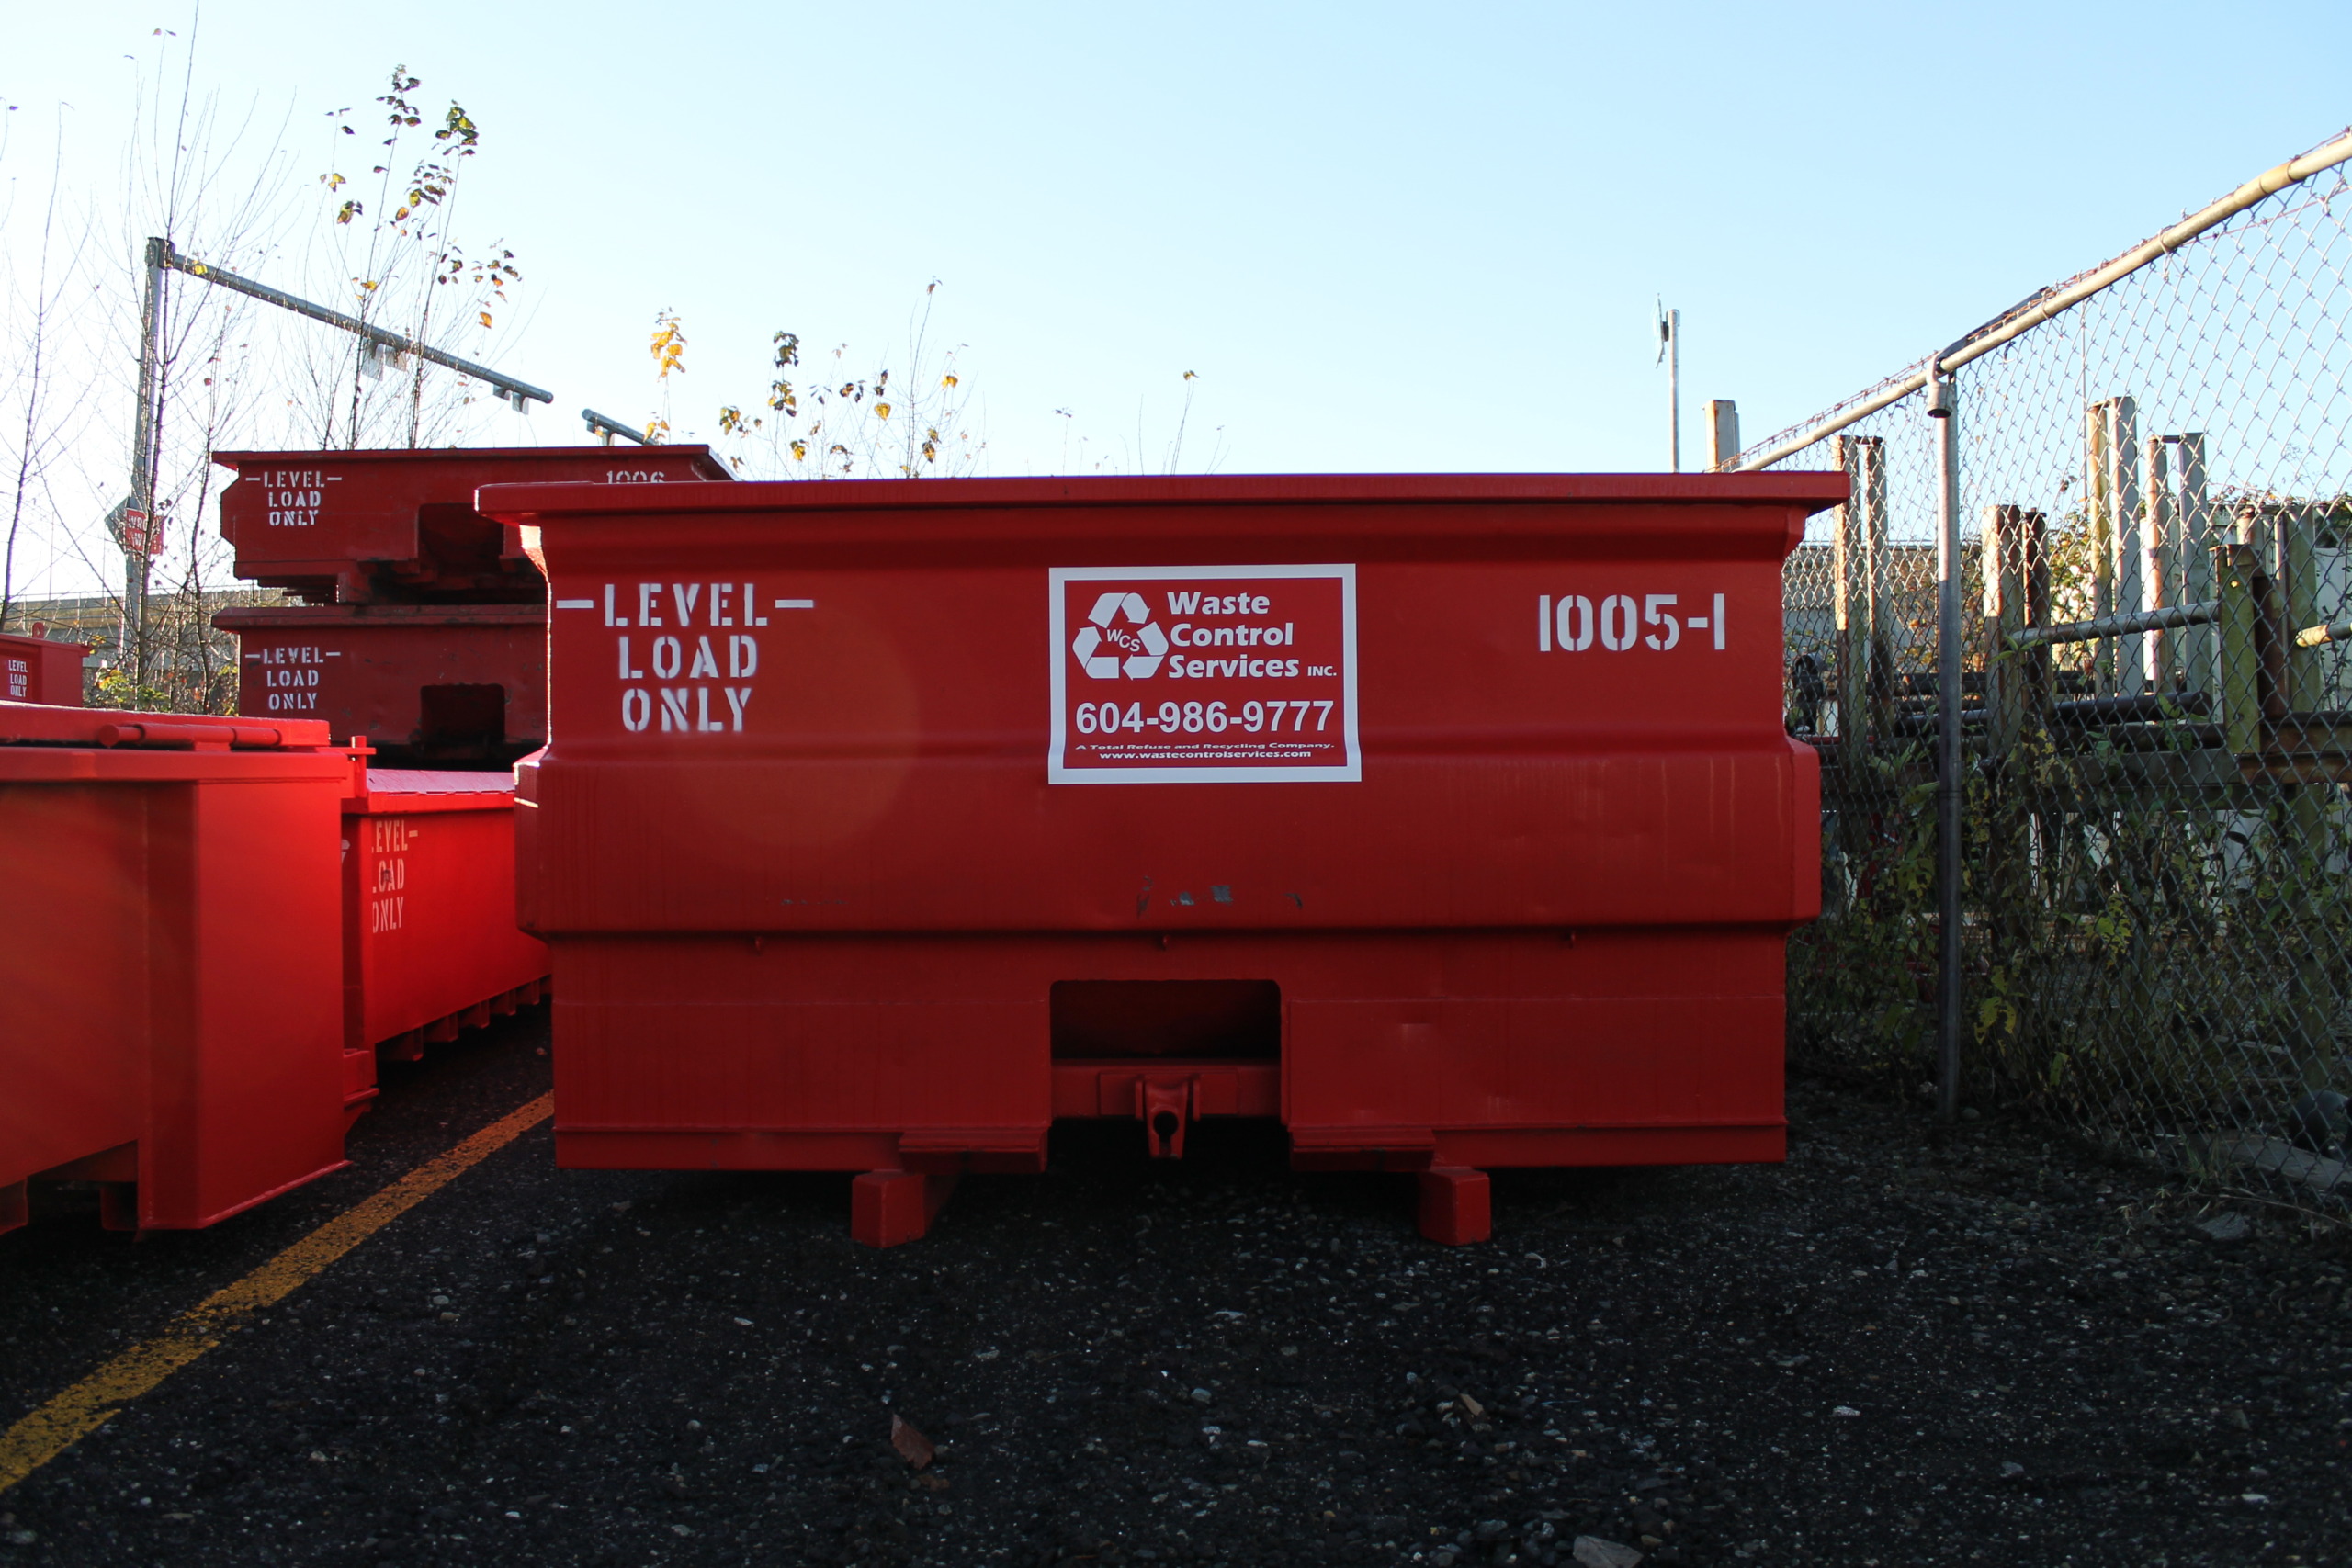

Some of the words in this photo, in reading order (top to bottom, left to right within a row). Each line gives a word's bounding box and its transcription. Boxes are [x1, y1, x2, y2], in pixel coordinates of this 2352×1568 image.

[268, 491, 322, 508] LOAD
[269, 509, 319, 526] ONLY
[1167, 591, 1271, 615] Waste
[1539, 592, 1726, 652] 1005-1
[1105, 628, 1141, 652] WCS
[1170, 622, 1294, 647] Control
[8, 660, 28, 673] LEVEL
[618, 635, 758, 679] LOAD
[1168, 654, 1300, 678] Services
[1307, 666, 1338, 677] INC.
[10, 673, 28, 686] LOAD
[266, 670, 320, 687] LOAD
[11, 685, 27, 698] ONLY
[268, 693, 318, 710] ONLY
[621, 687, 752, 732] ONLY
[1075, 700, 1334, 734] 604-986-9777
[1099, 751, 1312, 760] www.wastecontrolservices.com
